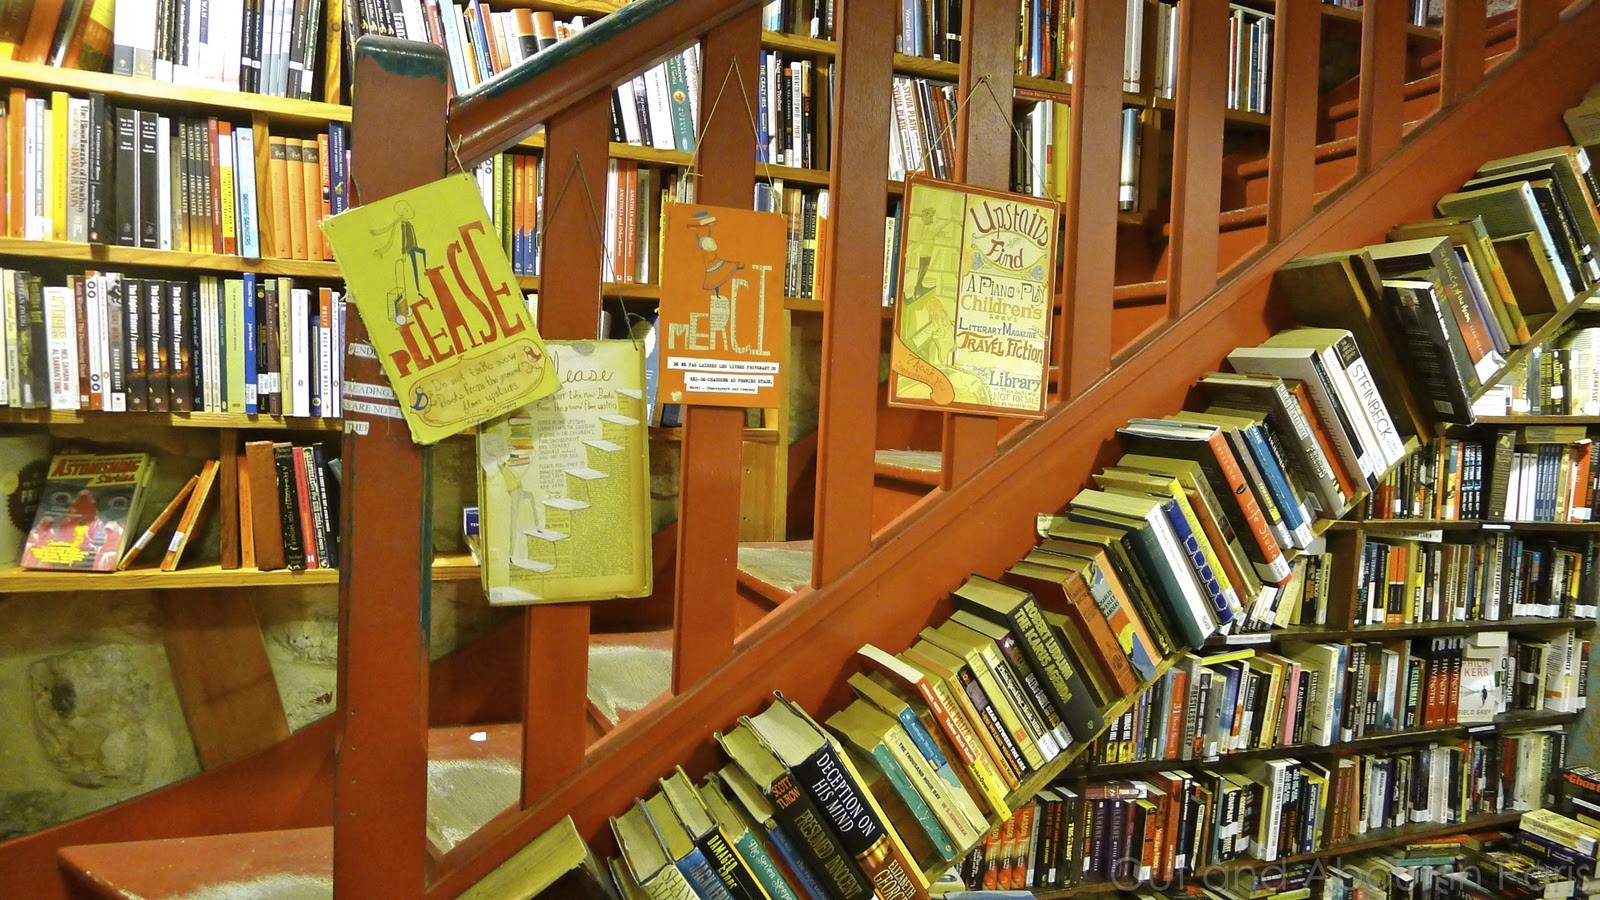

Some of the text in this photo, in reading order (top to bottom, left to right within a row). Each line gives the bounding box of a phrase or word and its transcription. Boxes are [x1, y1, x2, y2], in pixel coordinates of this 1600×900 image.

[80, 106, 88, 118] The
[893, 84, 907, 131] SYLVIA PLATH
[904, 81, 914, 109] SYLVIA
[79, 177, 87, 212] Broadway
[969, 201, 1049, 247] Upstairs
[986, 239, 1024, 269] Find
[389, 221, 526, 378] PLEASE
[967, 278, 975, 293] A
[668, 264, 773, 357] MERCI
[960, 295, 1042, 320] Children's
[431, 379, 448, 391] Do
[451, 373, 466, 385] not
[463, 382, 486, 396] from
[486, 374, 498, 388] the
[499, 364, 521, 380] ground
[552, 350, 614, 382] lease
[989, 370, 1041, 392] Library
[352, 403, 393, 415] ARE NOT
[993, 392, 1039, 404] NOT FOR SALE
[1351, 364, 1394, 442] STEINBECK
[1215, 441, 1235, 480] VREELAND
[1246, 500, 1259, 523] Life
[1101, 595, 1116, 612] WESLEY
[1014, 608, 1073, 704] THE ICARUS AGENDA
[1024, 600, 1074, 680] ROBERT LUDLUM
[1406, 669, 1421, 706] KELLERMAN
[1425, 663, 1441, 706] HYPNOTIST
[1435, 662, 1450, 705] HYPNOTIST
[1447, 661, 1462, 704] HYPNOTIST
[1464, 668, 1489, 677] KERR
[942, 693, 970, 736] THE PRIZE
[1122, 712, 1132, 740] TOBIAS HILL
[1172, 702, 1181, 714] 31
[1185, 690, 1199, 746] RESTLESS SLEEP
[945, 719, 976, 763] Yellow Back Radio
[985, 705, 1027, 770] READ BETWEEN THE LIES
[1109, 730, 1117, 741] HILL
[770, 776, 790, 800] SCOTT
[898, 741, 941, 800] THE THOUSAND HOUR DAY
[969, 763, 989, 792] Broke-Down
[776, 786, 801, 810] TUROW
[812, 778, 853, 834] HIS MIND
[816, 752, 876, 837] DECEPTION ON
[1223, 791, 1236, 823] COMPANY
[1021, 811, 1030, 836] LARSSON
[707, 835, 738, 872] DAMAGED
[748, 840, 759, 857] The
[759, 855, 776, 878] Seven
[796, 809, 864, 900] PRESUMED INNOCENT
[890, 858, 916, 898] ELIZABETH
